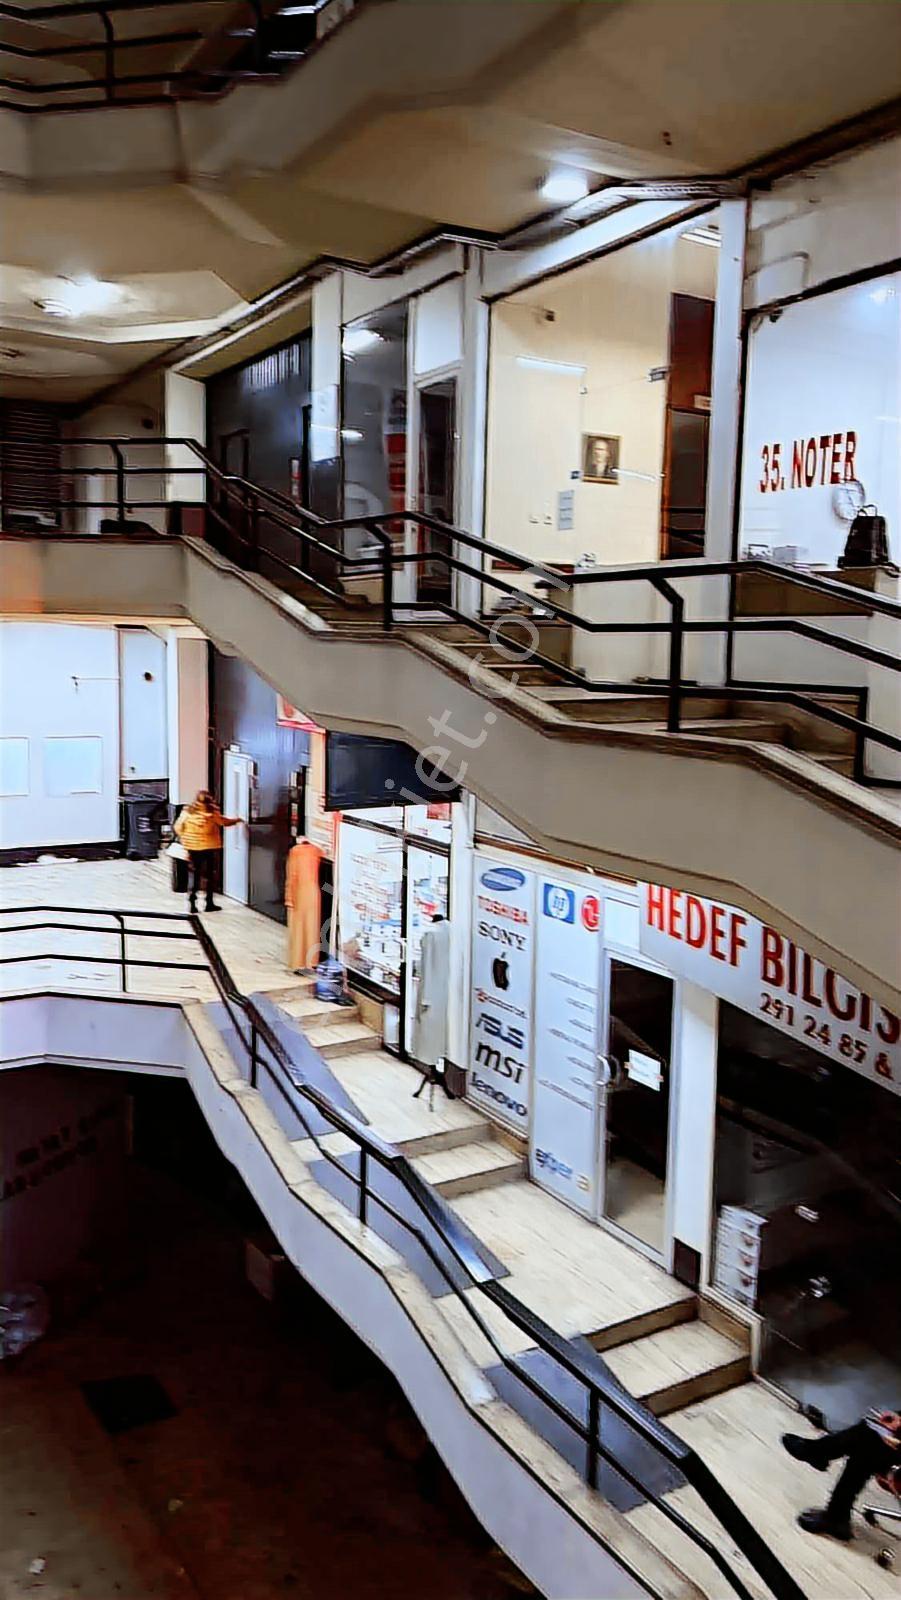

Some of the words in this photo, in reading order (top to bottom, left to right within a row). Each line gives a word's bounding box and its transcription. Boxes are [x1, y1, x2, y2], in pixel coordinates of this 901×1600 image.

[759, 444, 785, 493] 35.
[791, 431, 857, 489] NOTER
[477, 895, 529, 926] TOSHIBA
[647, 881, 747, 967] HEDEF
[478, 920, 527, 951] SONY
[475, 1012, 525, 1050] ASUS
[759, 992, 794, 1027] 291
[803, 1014, 832, 1046] 24
[838, 1033, 869, 1064] 85
[475, 1042, 526, 1084] msi
[470, 1072, 528, 1117] lenovo
